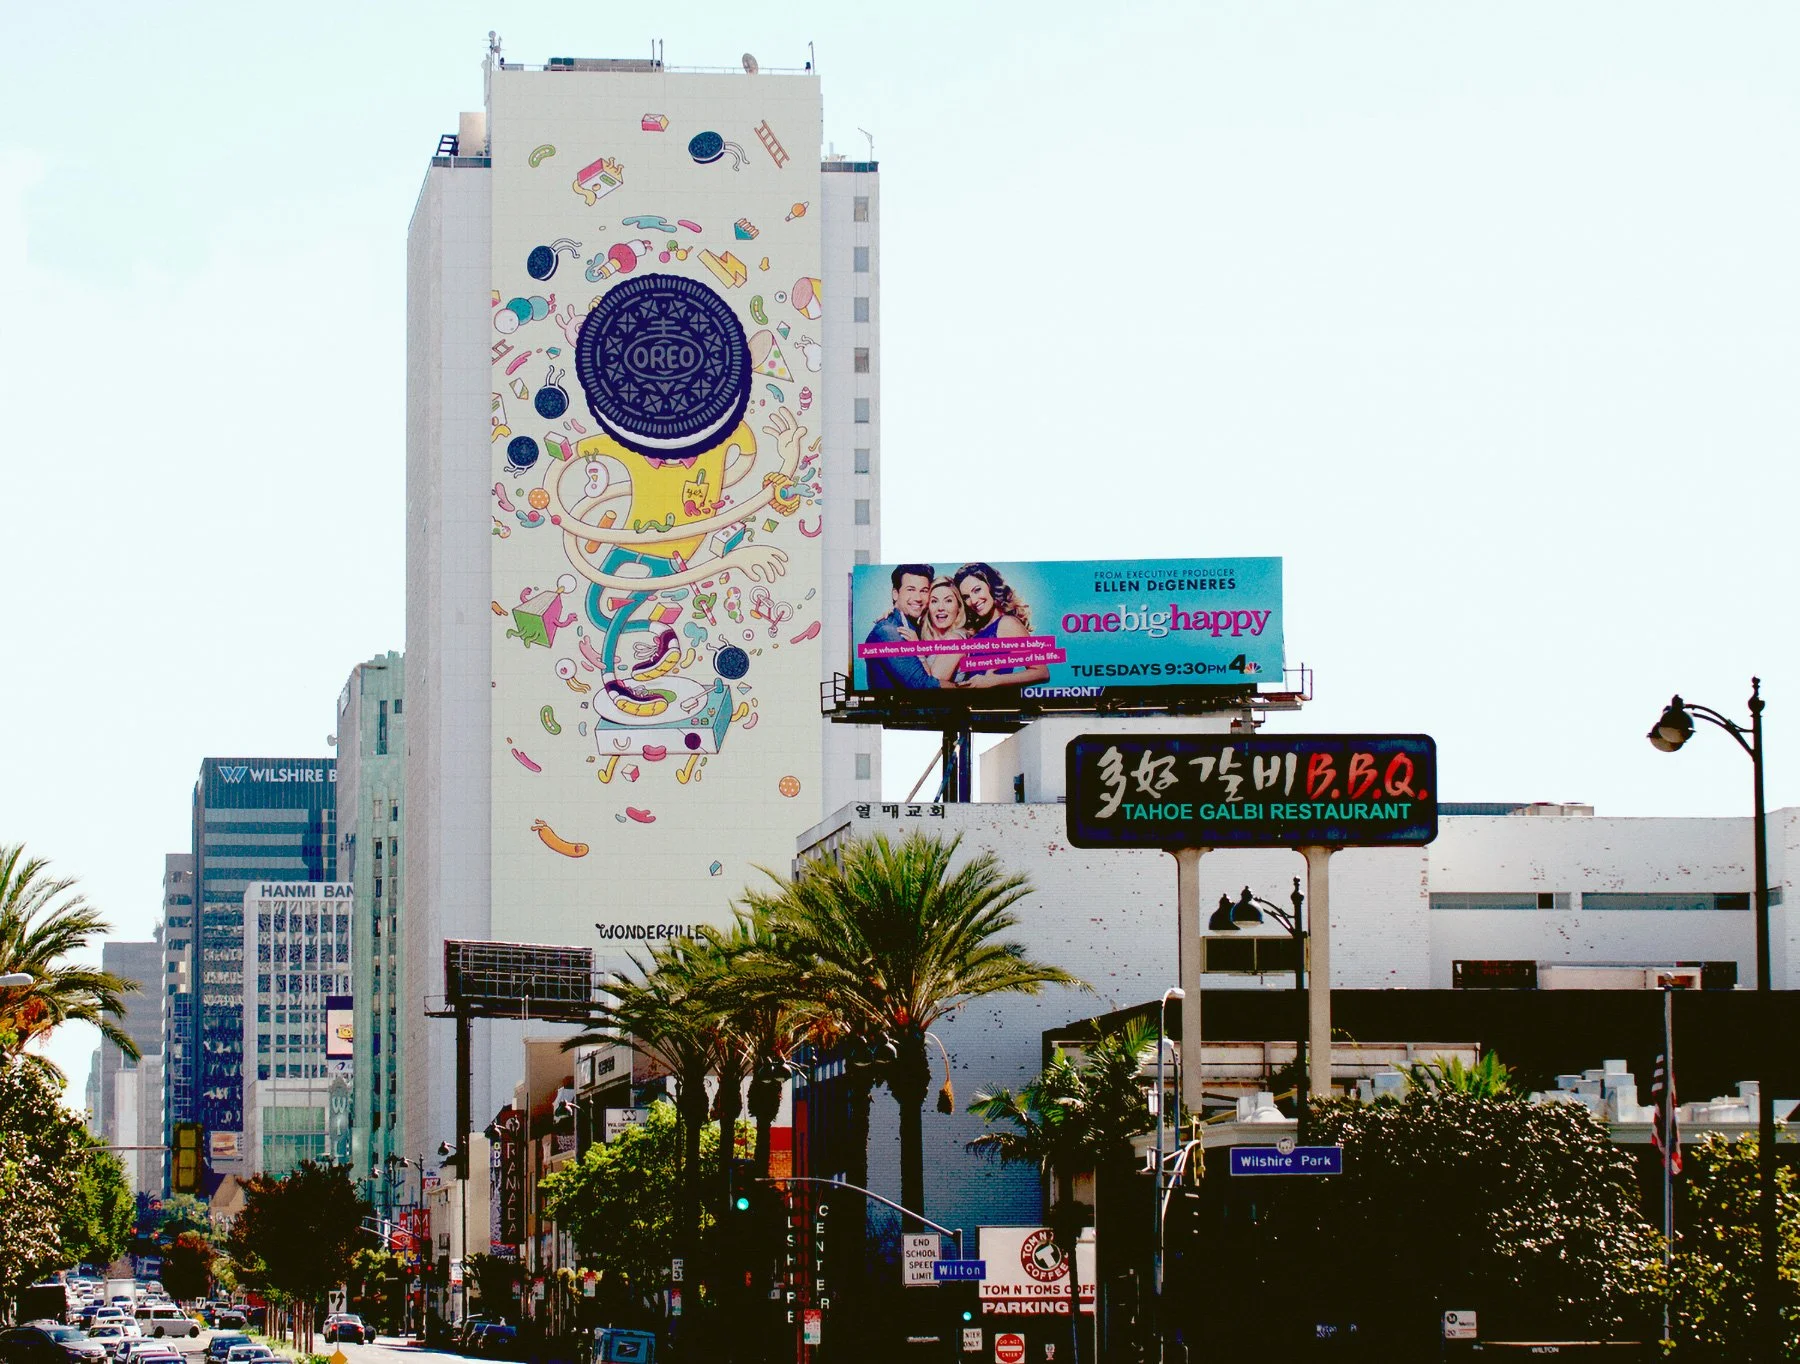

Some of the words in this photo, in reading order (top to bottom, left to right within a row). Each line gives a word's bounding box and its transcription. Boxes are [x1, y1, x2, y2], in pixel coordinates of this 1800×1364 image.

[633, 346, 695, 369] OREO
[1094, 569, 1122, 580] FROM
[1126, 569, 1178, 579] EXECUTIVE
[1182, 568, 1235, 578] PRODUCER
[1094, 580, 1140, 593] ELLEN
[862, 647, 878, 656] Just
[879, 646, 900, 655] when
[901, 645, 916, 654] two
[917, 643, 933, 653] best
[934, 642, 960, 653] friends
[960, 641, 990, 651] decided
[991, 641, 1000, 650] to
[1001, 639, 1019, 649] have
[965, 660, 976, 668] He
[977, 659, 994, 668] met
[994, 658, 1007, 666] the
[1007, 656, 1024, 665] love
[1025, 654, 1033, 664] of
[1034, 653, 1046, 663] his
[1071, 663, 1162, 677] TUESDAYS
[1228, 654, 1246, 675] 4
[250, 768, 324, 783] WILSHIRE
[1306, 752, 1429, 801] B.B.Q.
[1122, 803, 1193, 820] TAHOE
[1200, 803, 1264, 820] GALBI
[1270, 803, 1412, 820] RESTAURANT
[261, 885, 316, 898] HANMI
[1241, 1156, 1292, 1167] Wilshire
[1301, 1155, 1332, 1167] Park
[913, 1238, 930, 1247] END
[816, 1204, 830, 1310] CENTER
[905, 1249, 937, 1258] SCHOOL
[911, 1272, 932, 1280] LIMIT
[939, 1264, 981, 1275] Wilton
[1025, 1262, 1069, 1281] COFFEE
[983, 1285, 1009, 1295] TOM
[1014, 1285, 1022, 1294] N
[1030, 1285, 1061, 1295] TOMS
[982, 1301, 1069, 1314] PARKING
